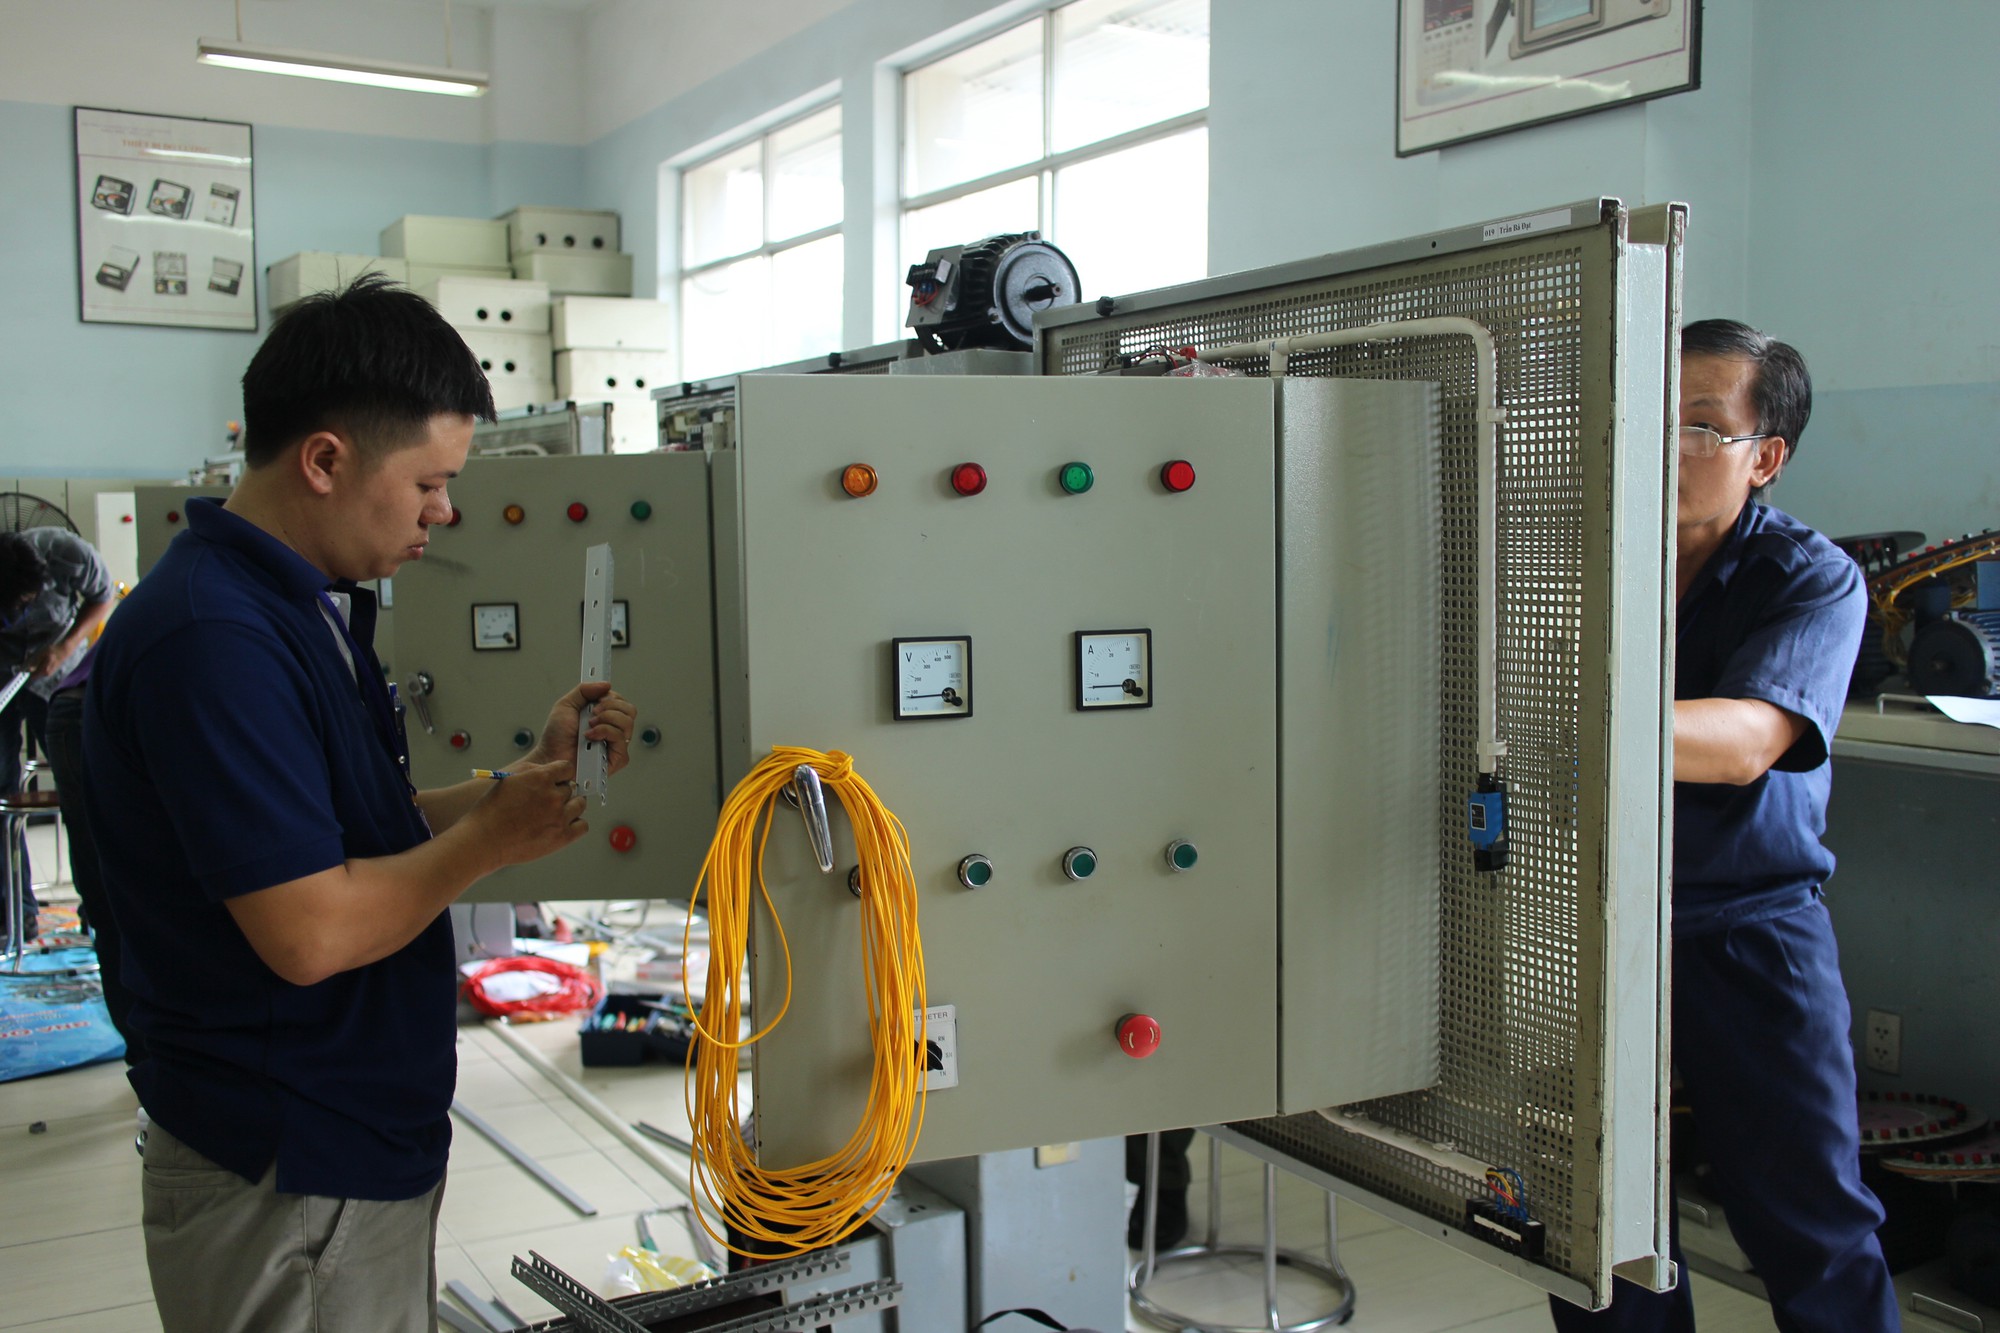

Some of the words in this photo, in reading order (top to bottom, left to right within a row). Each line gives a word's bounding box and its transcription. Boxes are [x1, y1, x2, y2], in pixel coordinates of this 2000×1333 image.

[1485, 229, 1494, 237] 019
[636, 545, 679, 589] 13
[1088, 645, 1094, 655] A
[905, 652, 912, 663] V
[914, 1011, 948, 1022] TETER
